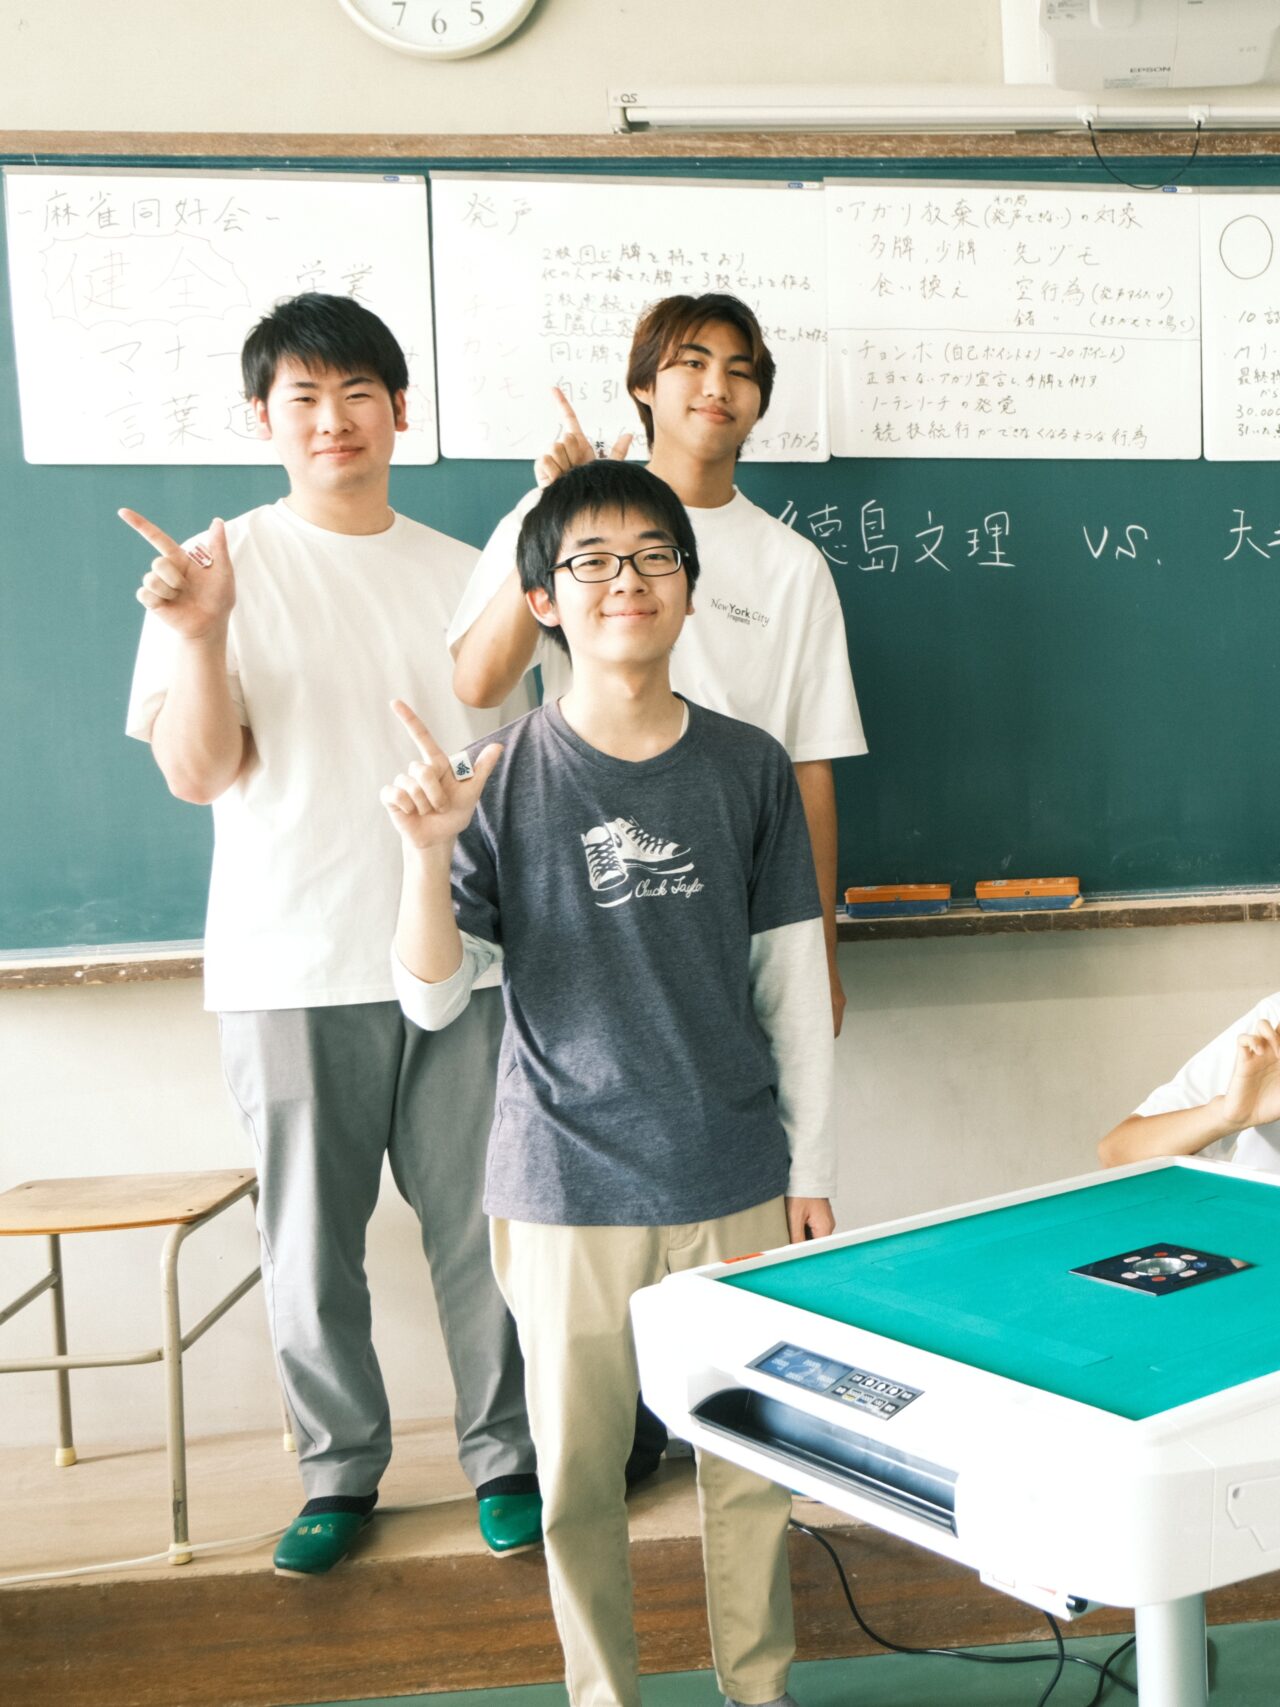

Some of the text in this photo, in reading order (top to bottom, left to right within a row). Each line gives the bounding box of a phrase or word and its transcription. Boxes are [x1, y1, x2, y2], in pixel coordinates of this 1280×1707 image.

[391, 1, 407, 27] 7
[431, 9, 447, 35] 6
[469, 0, 485, 26] 5
[56, 246, 227, 318] 健全
[711, 598, 771, 628] New York City
[635, 875, 705, 898] Chuck Taylor
